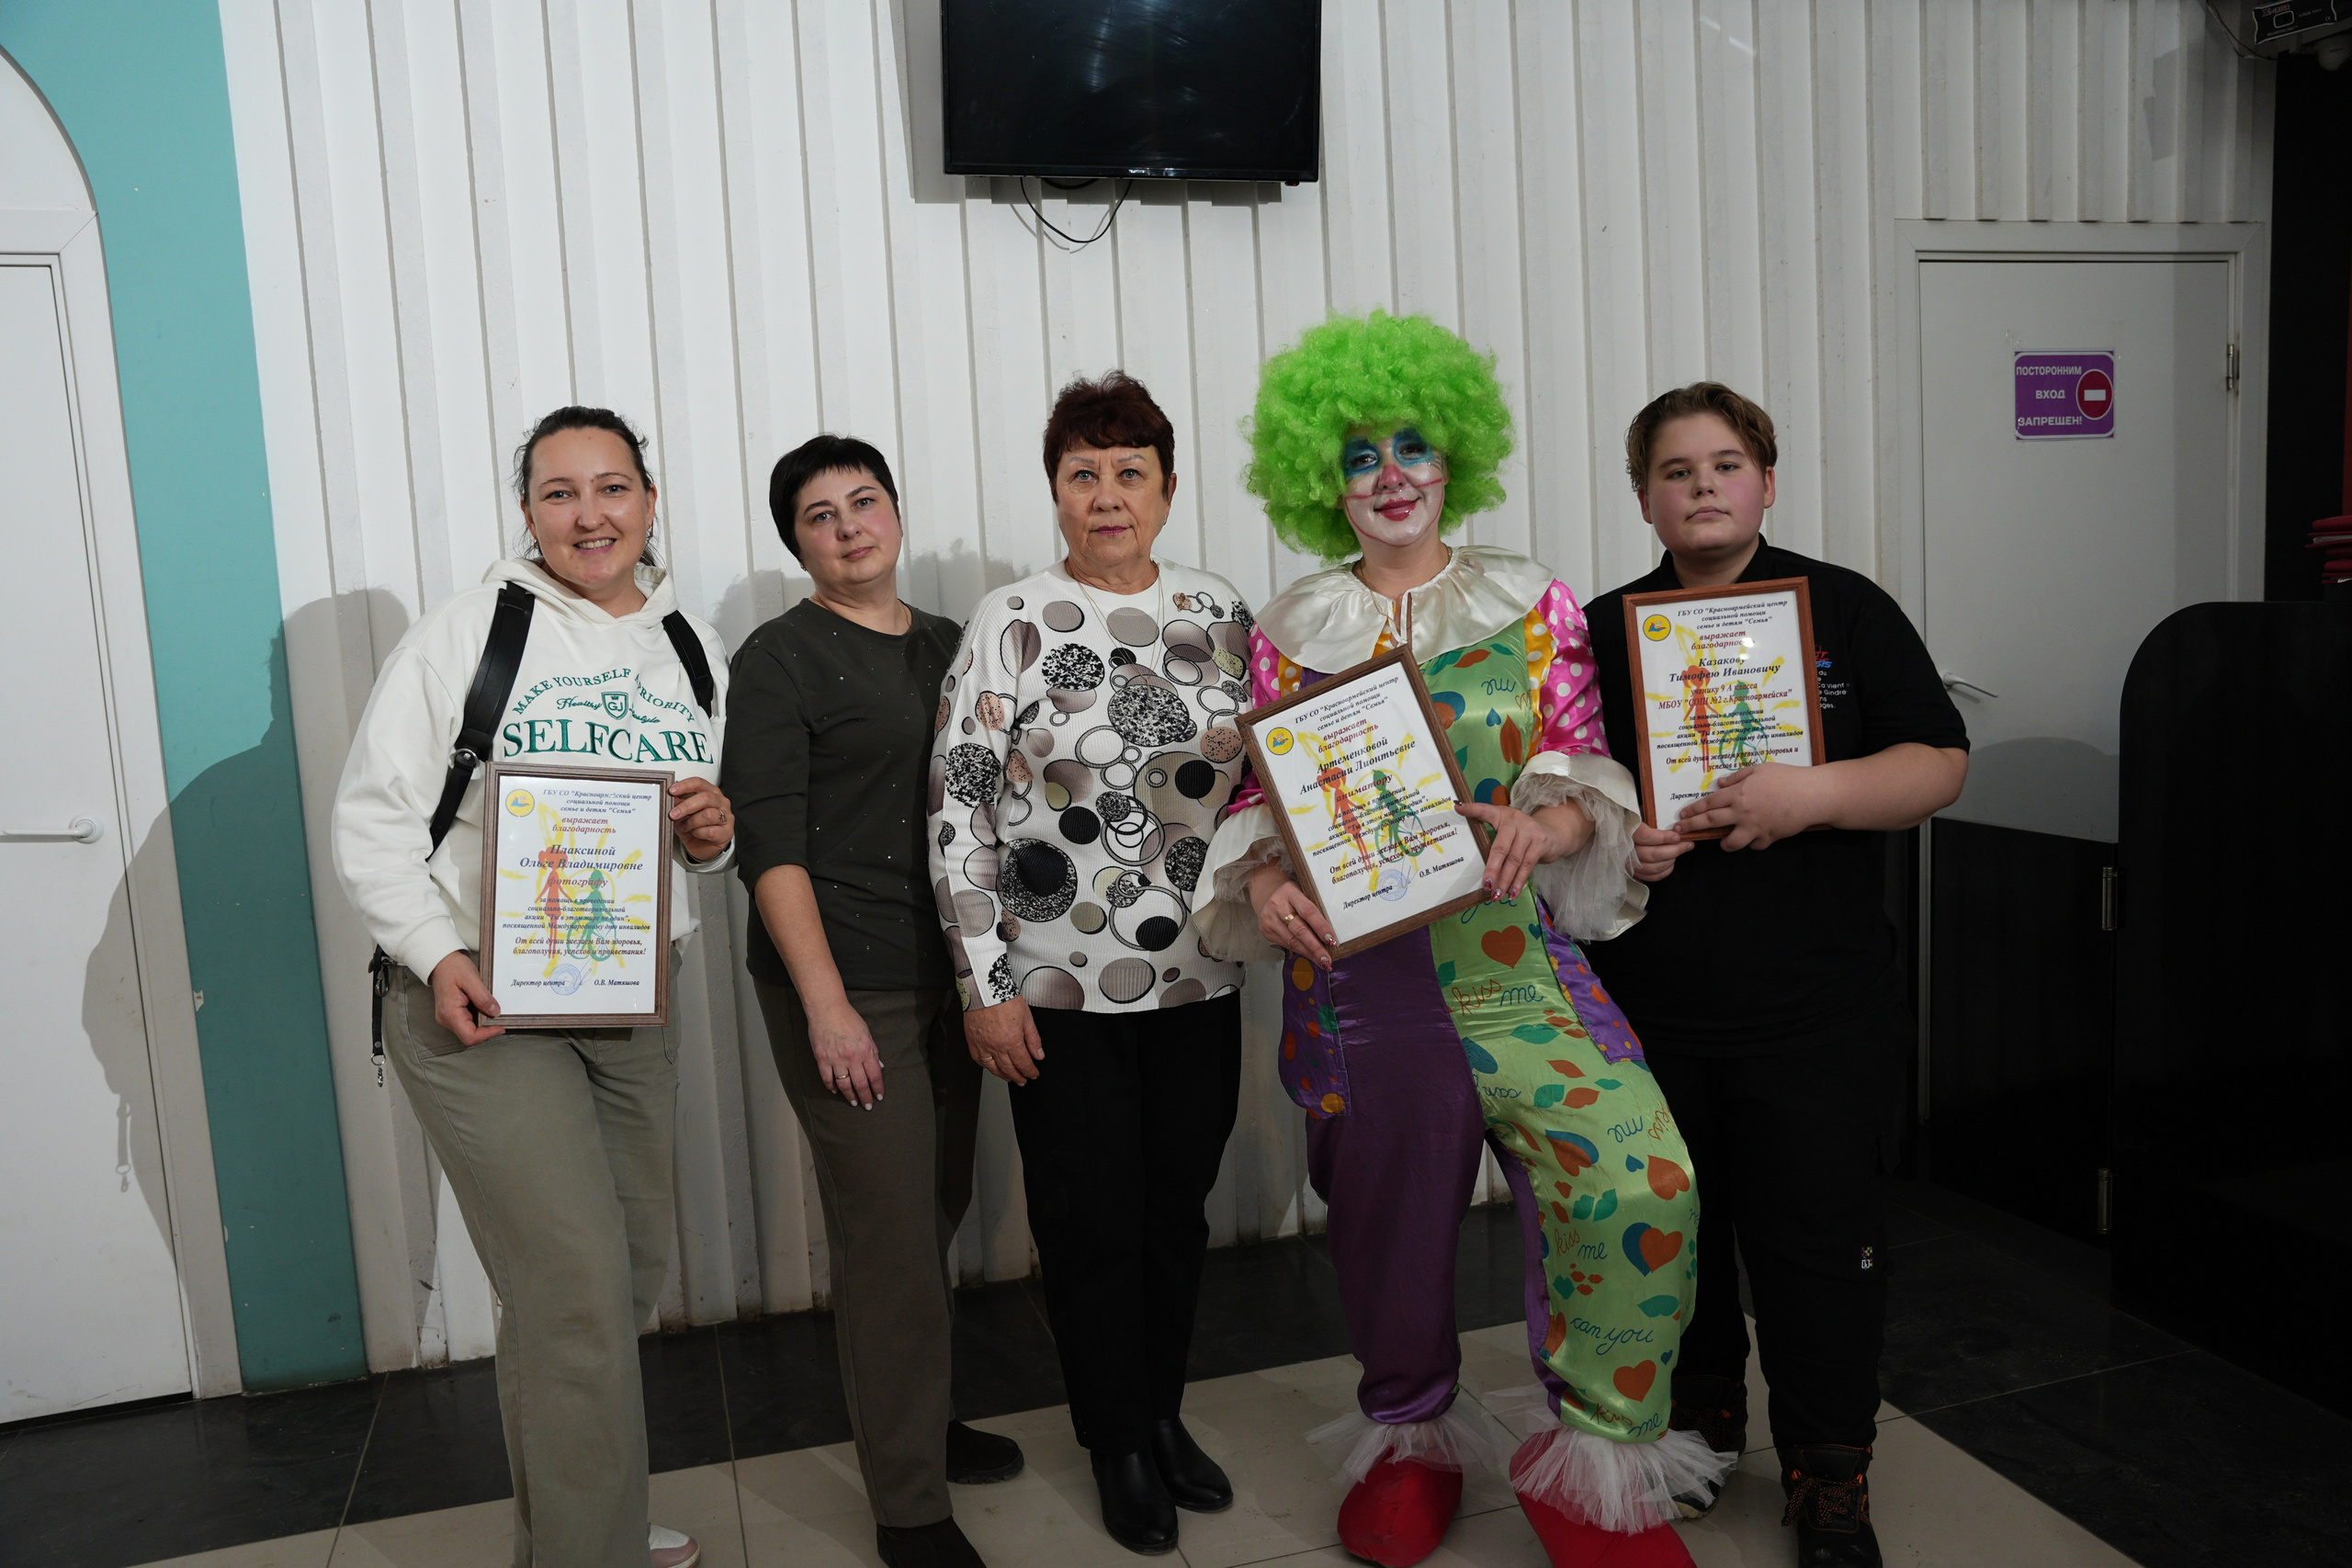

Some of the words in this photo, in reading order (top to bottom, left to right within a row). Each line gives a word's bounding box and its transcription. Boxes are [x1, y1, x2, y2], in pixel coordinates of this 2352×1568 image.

[2016, 367, 2082, 376] ПОСТОРОННИМ
[2035, 389, 2065, 399] ВХОД
[1766, 600, 1787, 608] центр
[1701, 612, 1737, 621] социальной
[1690, 637, 1755, 650] благодарнос
[1699, 630, 1746, 641] выражает
[1668, 669, 1720, 683] Тимофею
[1722, 662, 1781, 678] Ивановичу
[512, 680, 553, 715] MAKE
[553, 668, 631, 687] YOURSELF
[636, 682, 695, 723] PRIORITY
[1690, 684, 1719, 696] ученику
[556, 696, 604, 710] Healthy
[607, 701, 624, 712] GJ
[1294, 713, 1309, 724] ГБУ
[1308, 708, 1319, 717] СО
[1377, 675, 1398, 689] центр
[1318, 702, 1354, 722] социальной
[1354, 692, 1381, 706] помощи
[1657, 699, 1682, 709] МБОУ
[1316, 719, 1334, 731] семье
[1339, 707, 1361, 722] детям
[1317, 722, 1379, 754] благодарность
[1322, 717, 1367, 742] выражает
[1770, 729, 1803, 738] инвалидов
[503, 719, 714, 764] SELFCARE
[1314, 736, 1388, 774] Артеменковой
[1297, 764, 1353, 795] Анастасии
[1353, 740, 1416, 772] Лионтьевне
[571, 790, 630, 799] "Красноармский
[1334, 773, 1394, 804] аниматору
[1669, 790, 1699, 800] Директор
[1419, 795, 1452, 813] инвалидов
[552, 824, 616, 834] благодарность
[561, 817, 607, 825] выражает
[1328, 829, 1347, 840] акции
[549, 844, 616, 855] Плаксиной
[1329, 863, 1341, 874] От
[1340, 857, 1356, 869] всей
[1403, 832, 1418, 843] Вам
[519, 857, 553, 868] Ольге
[558, 858, 642, 872] Владимировне
[1431, 855, 1464, 873] Матяшова
[547, 876, 607, 887] фотографу
[1341, 892, 1372, 909] Директор
[1371, 884, 1393, 897] центра
[1452, 978, 1502, 1016] kiss
[1500, 985, 1544, 1007] me
[1555, 1228, 1580, 1258] kiss
[1577, 1242, 1608, 1260] me
[1570, 1317, 1600, 1338] can
[1595, 1327, 1654, 1356] you
[1627, 1413, 1663, 1438] me
